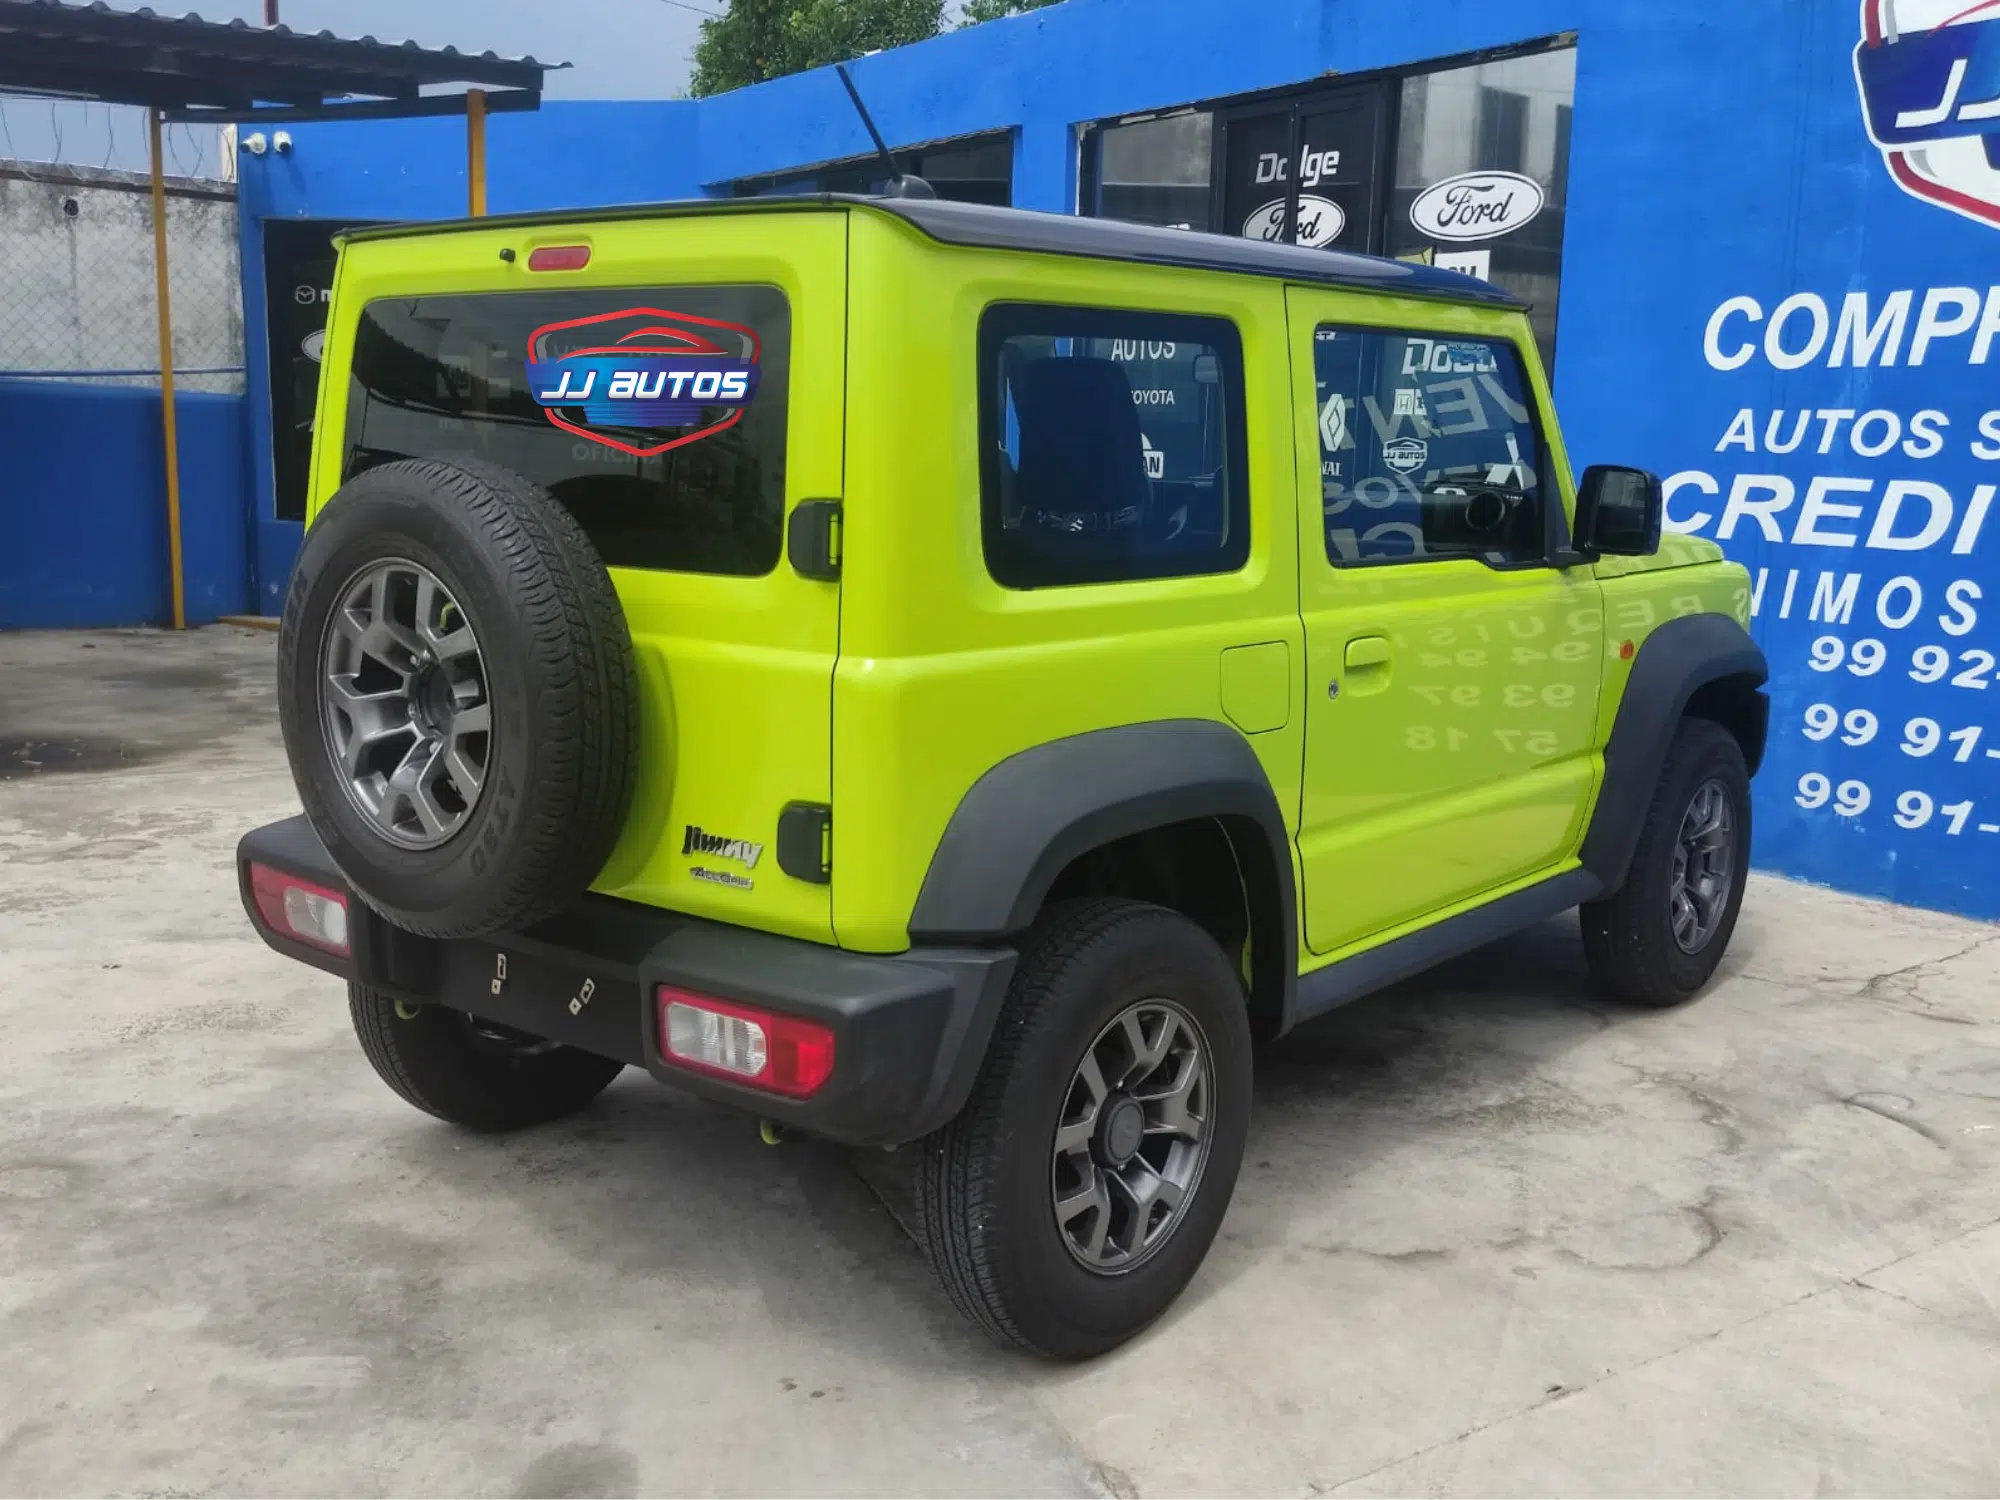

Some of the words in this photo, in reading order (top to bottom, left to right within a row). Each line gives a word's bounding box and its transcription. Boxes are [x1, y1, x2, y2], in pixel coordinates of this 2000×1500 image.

[1263, 204, 1322, 241] Fd
[1437, 184, 1514, 227] Ford
[1131, 389, 1176, 405] OYOTA
[1714, 408, 1950, 459] AUTOS
[1662, 470, 1998, 554] CREDI
[1807, 635, 1887, 677] 99
[1802, 703, 1879, 746] 99
[1794, 772, 1871, 816] 99
[682, 825, 763, 870] Jimny
